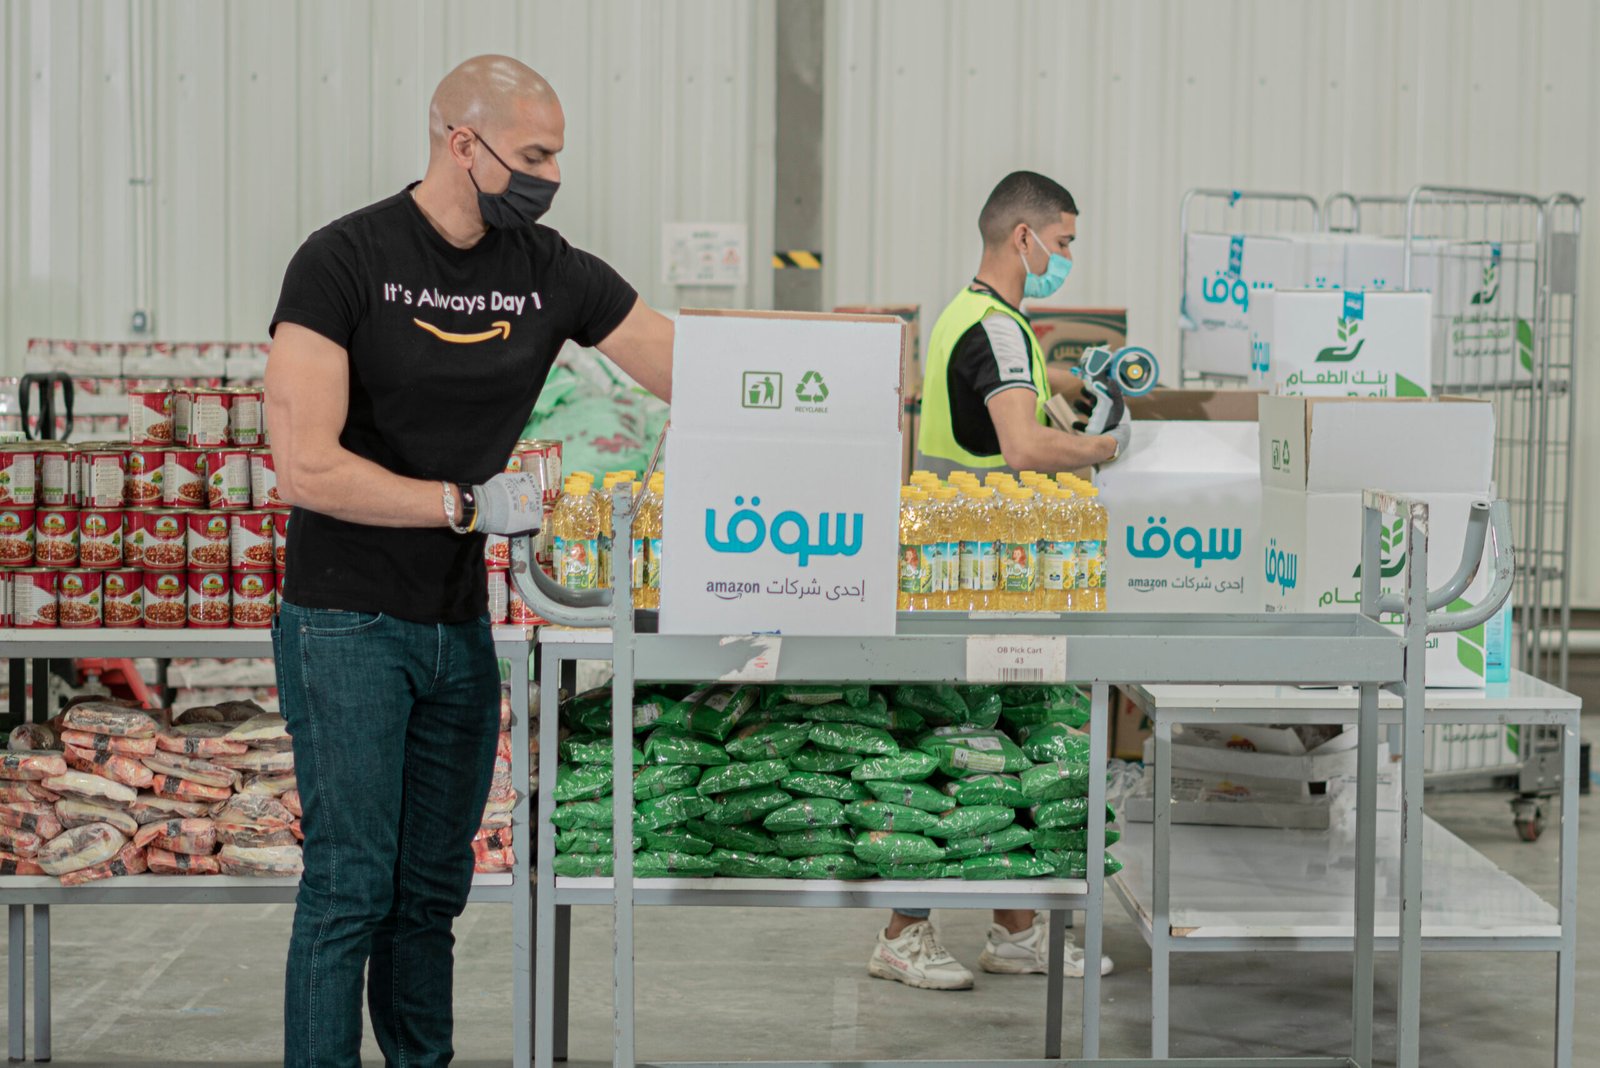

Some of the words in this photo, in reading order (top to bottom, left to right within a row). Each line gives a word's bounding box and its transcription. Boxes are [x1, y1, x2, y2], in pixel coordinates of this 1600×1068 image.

[384, 283, 412, 304] It's
[417, 288, 486, 315] Always
[491, 291, 526, 316] Day
[531, 292, 542, 310] 1
[1286, 370, 1348, 387] الطعام
[1352, 370, 1388, 384] بنك
[794, 406, 829, 414] RECYCLABLE
[705, 495, 864, 567] سوق
[1125, 516, 1242, 568] سوق
[1265, 538, 1297, 596] سوق
[706, 580, 760, 596] amazon
[766, 577, 821, 599] شركات
[826, 579, 865, 602] إحدى
[1128, 577, 1167, 590] amazon
[1171, 576, 1212, 591] شركات
[1214, 576, 1244, 594] إحدى
[997, 646, 1008, 654] OB
[1010, 646, 1025, 654] Pick
